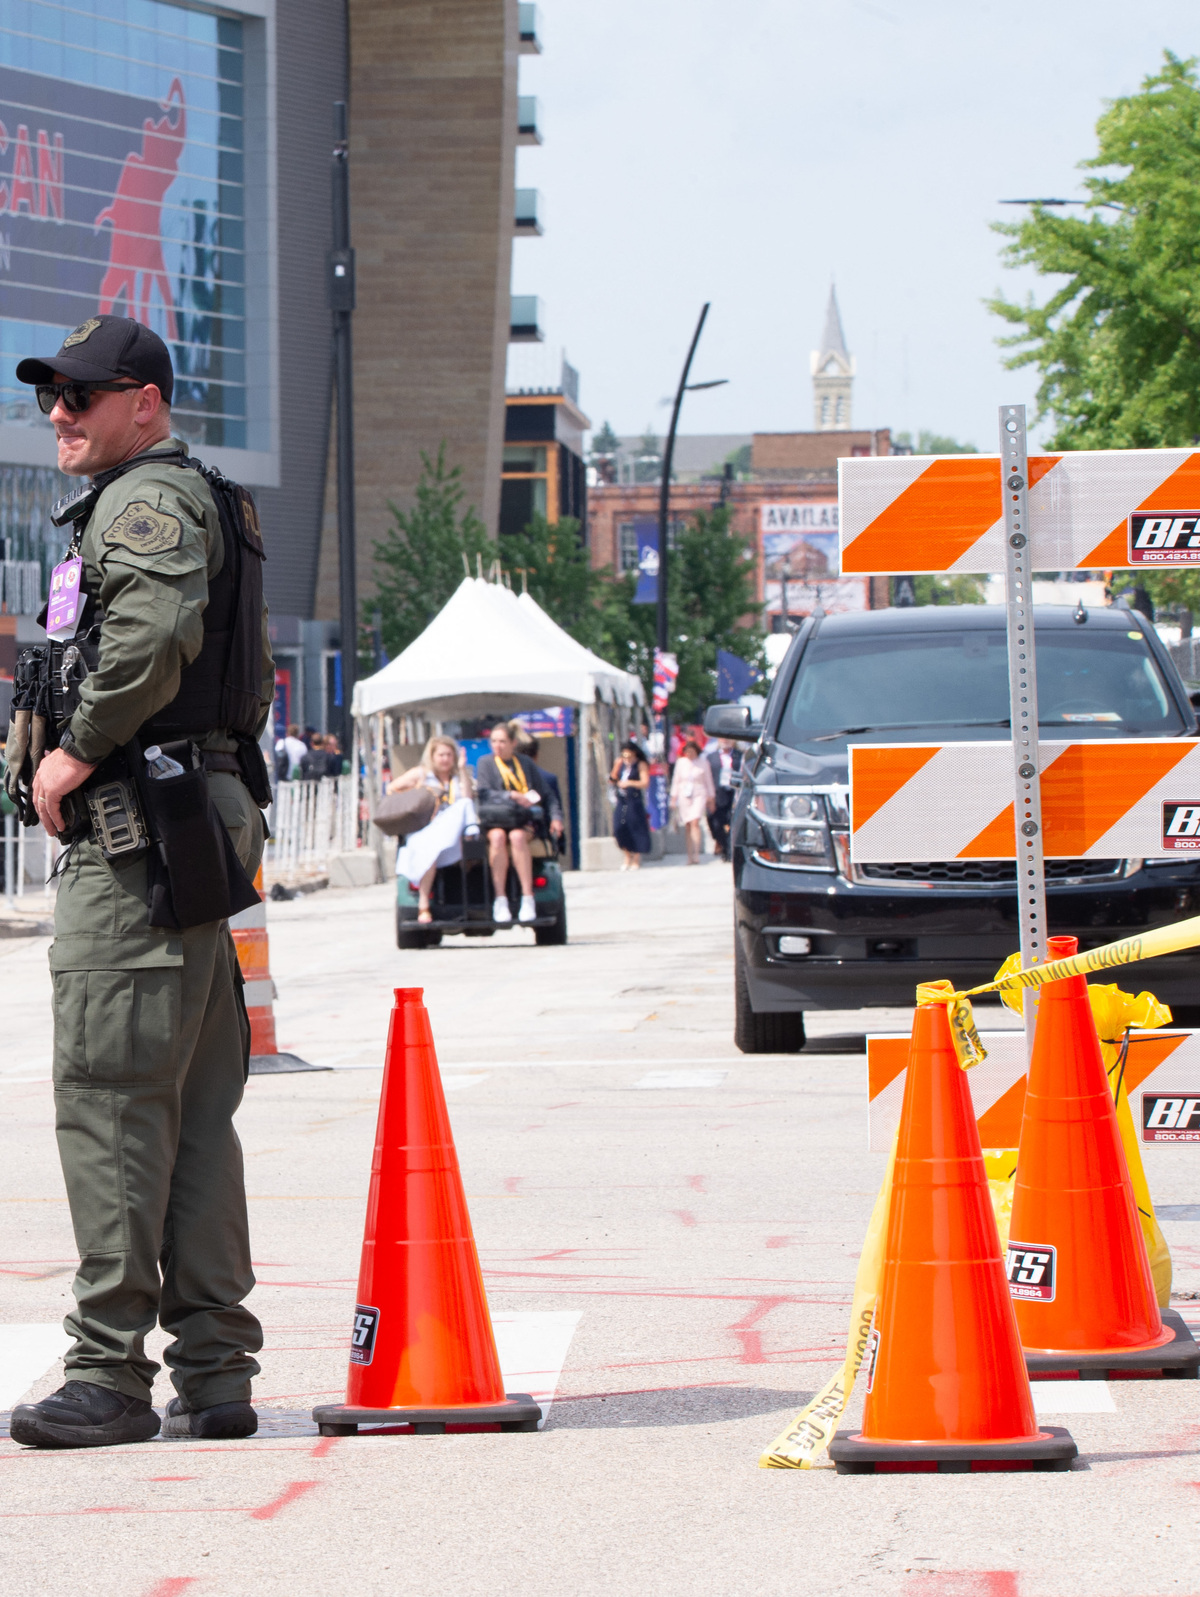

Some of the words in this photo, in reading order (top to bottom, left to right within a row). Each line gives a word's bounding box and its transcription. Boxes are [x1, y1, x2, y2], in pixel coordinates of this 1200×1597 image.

[108, 504, 144, 539] POLICE
[1005, 1249, 1050, 1284] FS
[352, 1313, 374, 1346] S
[786, 1420, 825, 1450] DO
[809, 1382, 845, 1419] NOT
